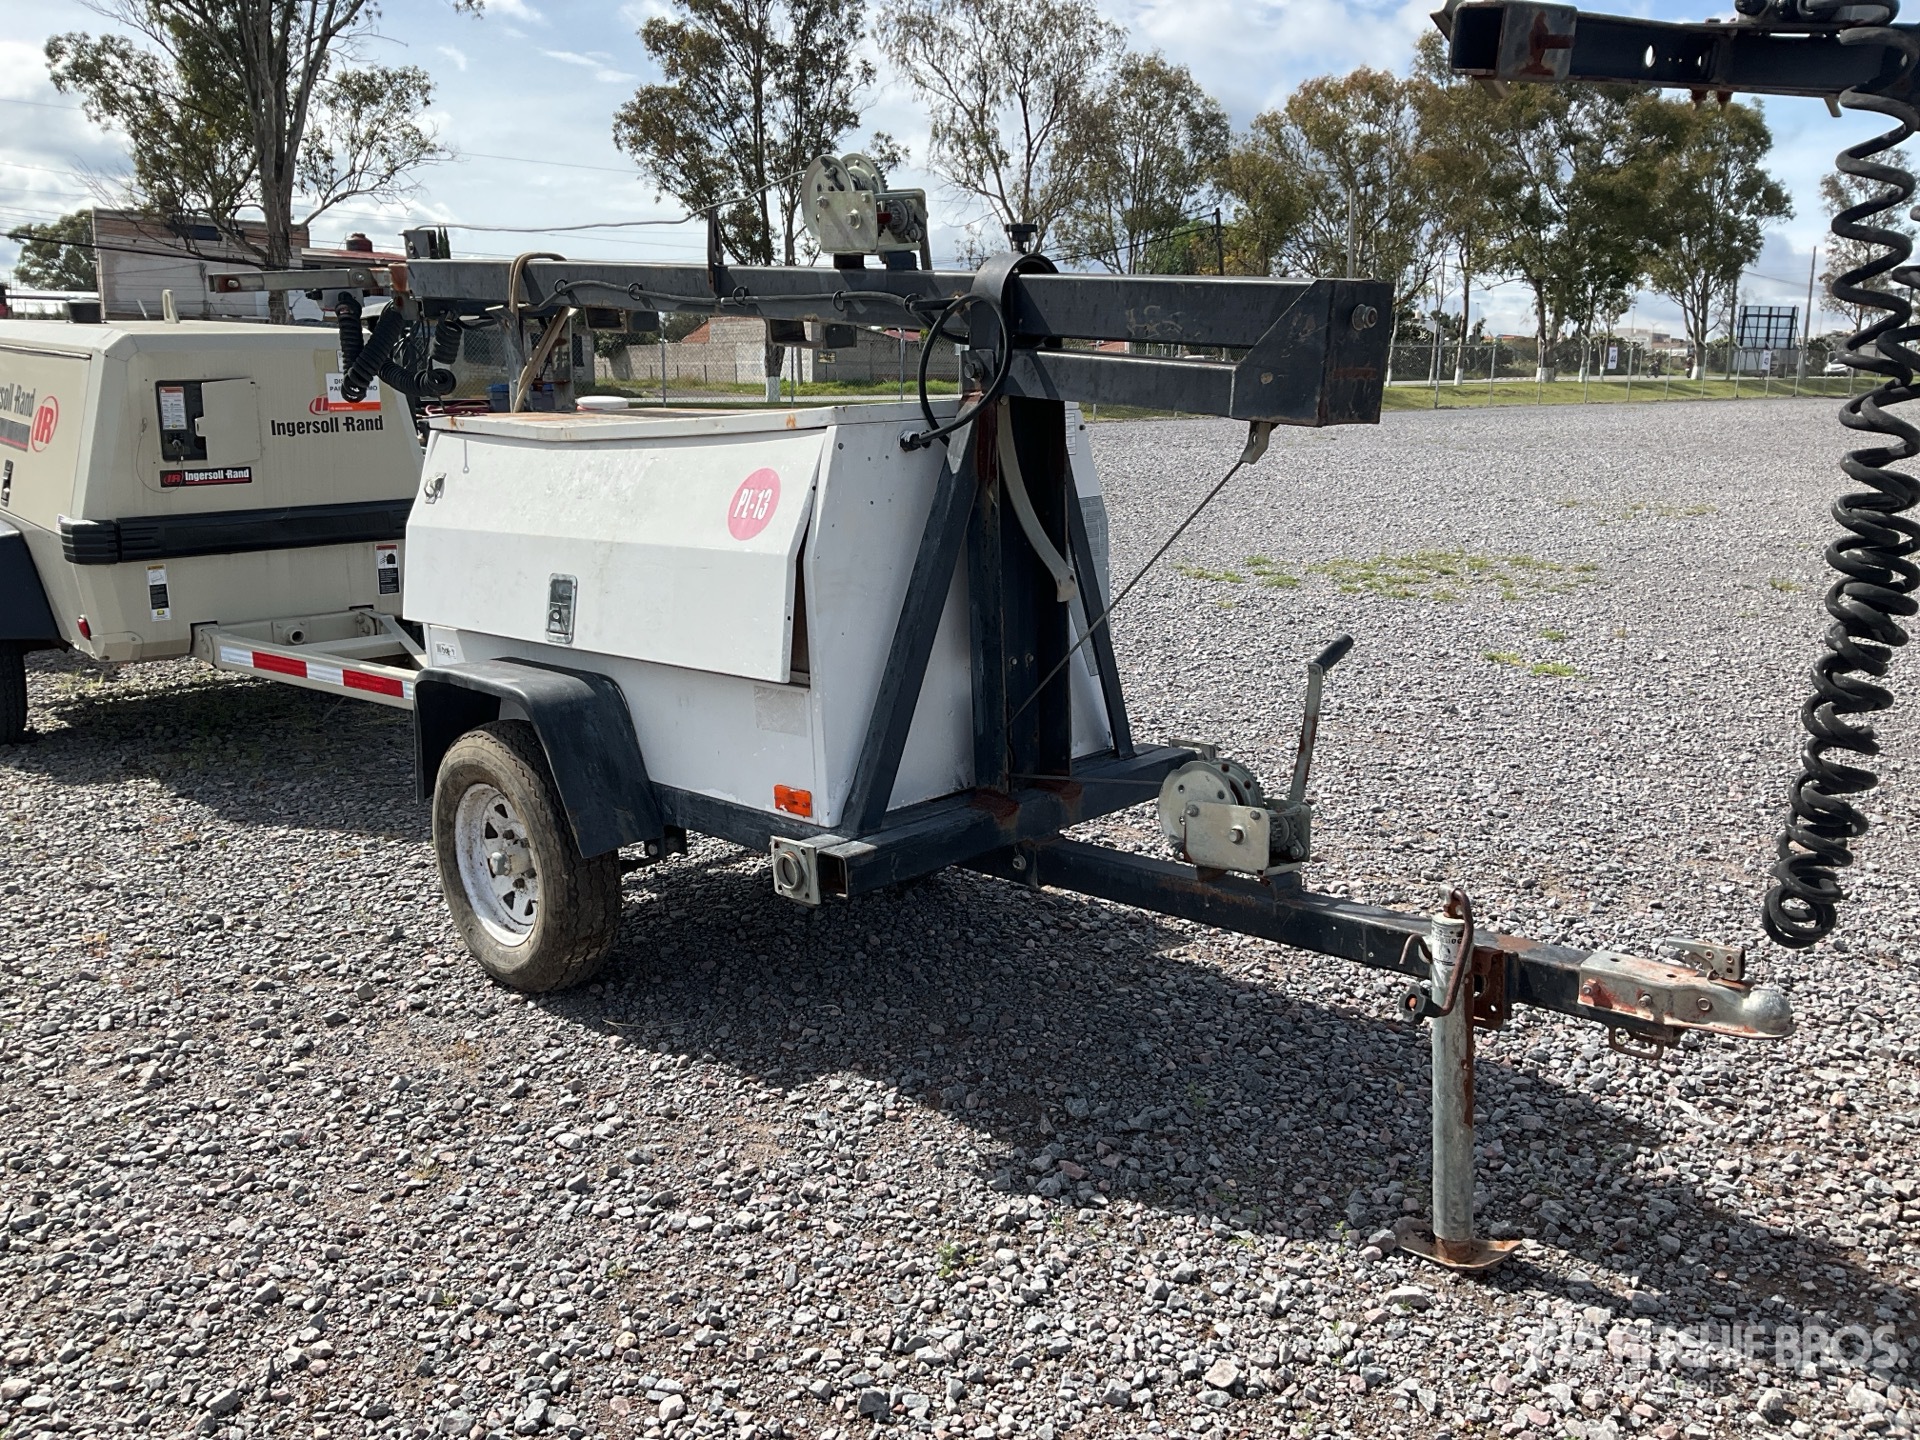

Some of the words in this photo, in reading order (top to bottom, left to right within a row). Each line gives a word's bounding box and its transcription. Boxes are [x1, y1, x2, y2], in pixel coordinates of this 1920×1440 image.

[35, 405, 54, 444] IR
[271, 416, 339, 437] Ingersoll
[185, 469, 223, 482] Ingersoll
[733, 488, 773, 520] PL-13
